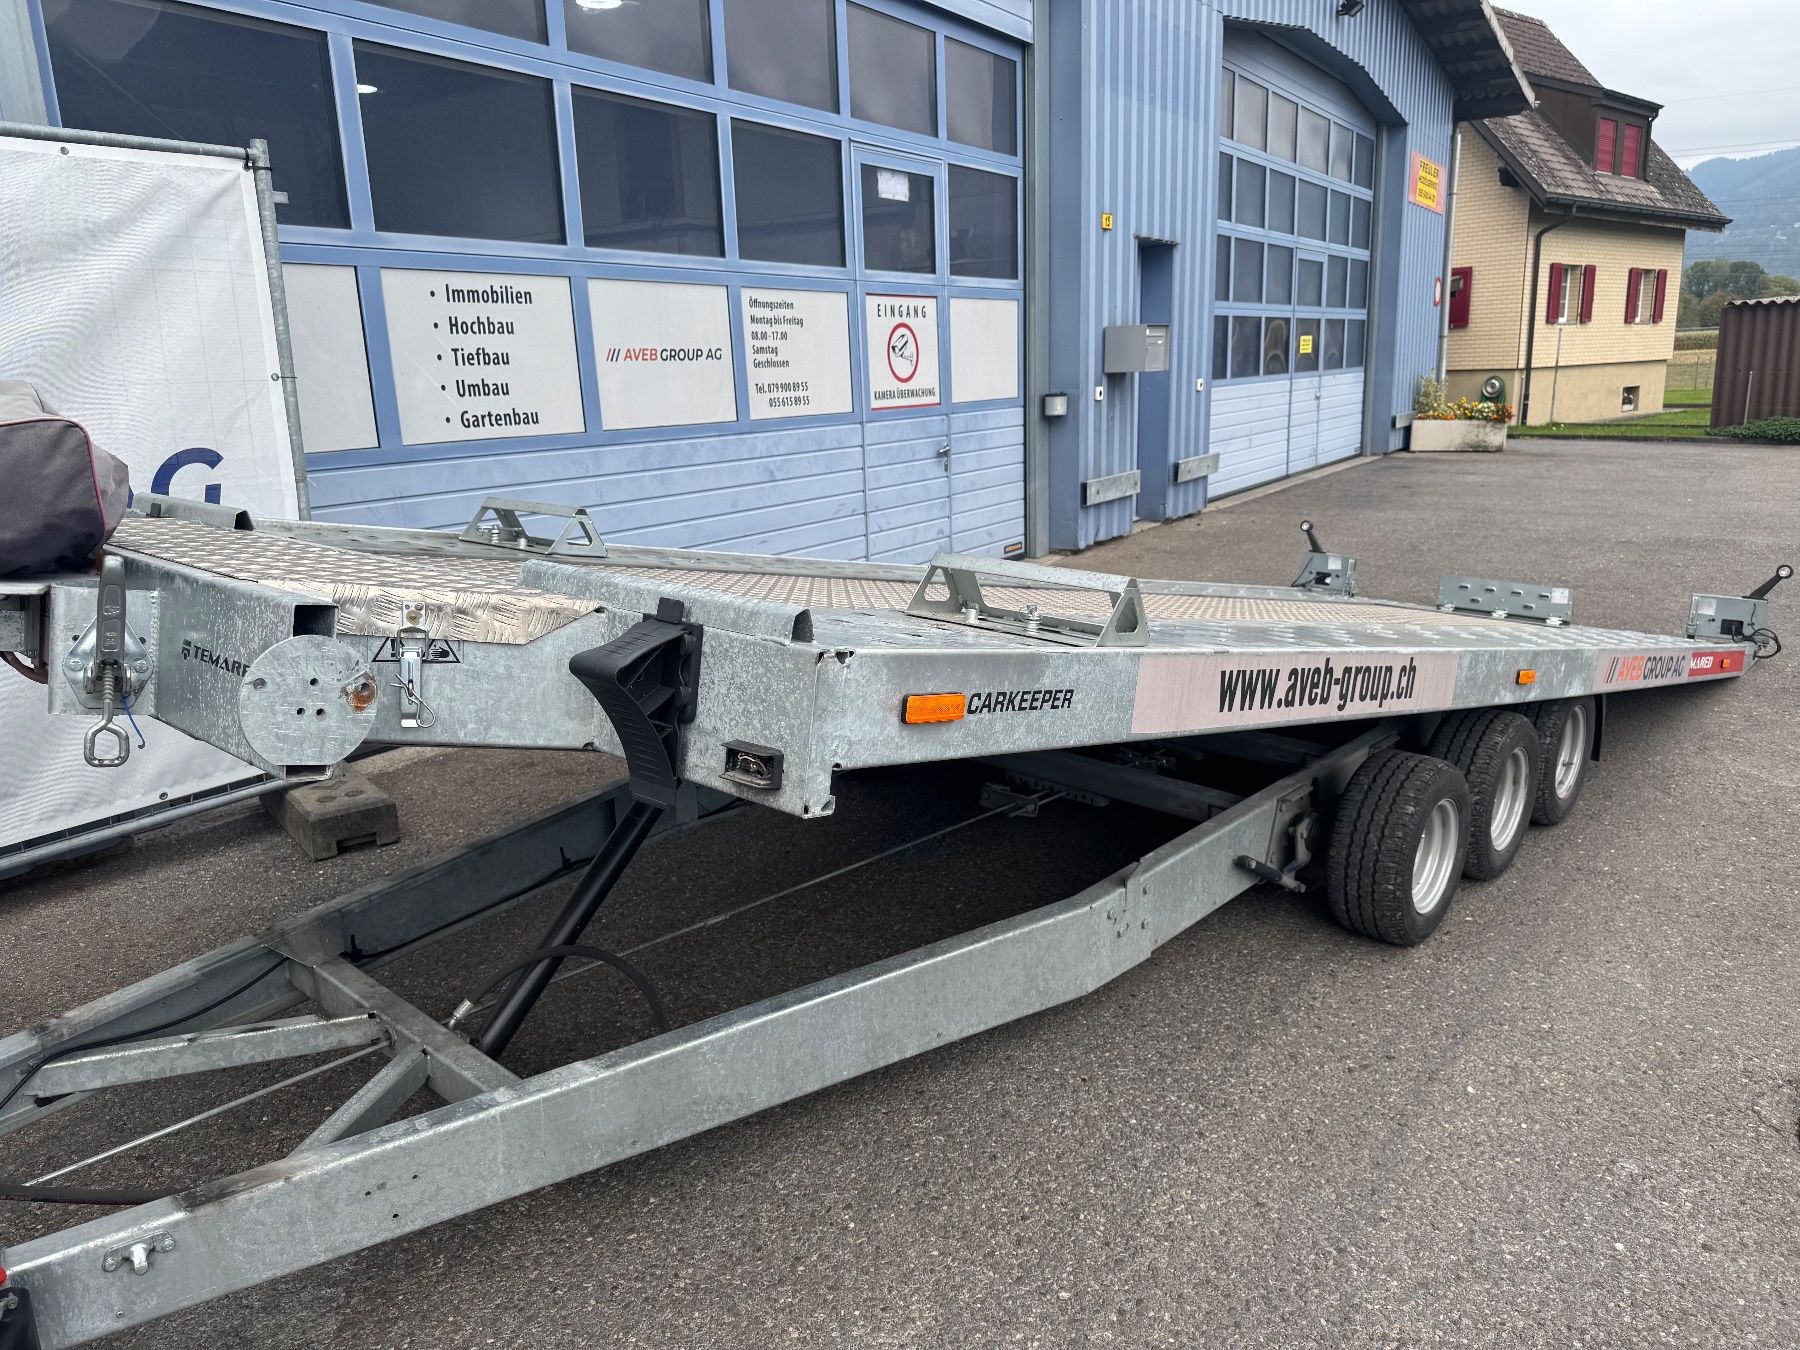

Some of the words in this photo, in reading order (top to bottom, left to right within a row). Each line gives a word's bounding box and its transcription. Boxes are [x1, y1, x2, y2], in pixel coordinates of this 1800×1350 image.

[445, 283, 533, 305] Immobilien
[748, 296, 794, 311] Öffnungszeiten
[877, 303, 927, 319] EINGANG
[448, 316, 515, 335] Hochbau
[750, 314, 773, 328] Montag
[774, 315, 782, 326] bis
[783, 315, 804, 328] Freitag
[751, 331, 768, 341] 08.00
[772, 331, 788, 341] 17.00
[450, 347, 510, 367] Tiefbau
[623, 348, 658, 361] AVEB
[660, 348, 704, 362] GROUP
[705, 347, 723, 361] AG
[752, 344, 779, 357] Samstag
[753, 358, 790, 369] Geschlossen
[455, 378, 510, 398] Umbau
[755, 383, 767, 395] Tel.
[767, 382, 779, 394] 079
[780, 381, 792, 393] 900
[792, 381, 800, 392] 89
[801, 381, 809, 392] 55
[874, 389, 897, 401] KAMERA
[896, 387, 936, 399] ÜBERWACHUNG
[460, 407, 540, 429] Gartenbau
[1616, 655, 1645, 681] AVEB
[1643, 655, 1673, 680] GROUP
[1671, 655, 1686, 678] AG
[1218, 656, 1417, 713] www.aveb-group.ch
[966, 688, 1075, 715] CARKEEPER
